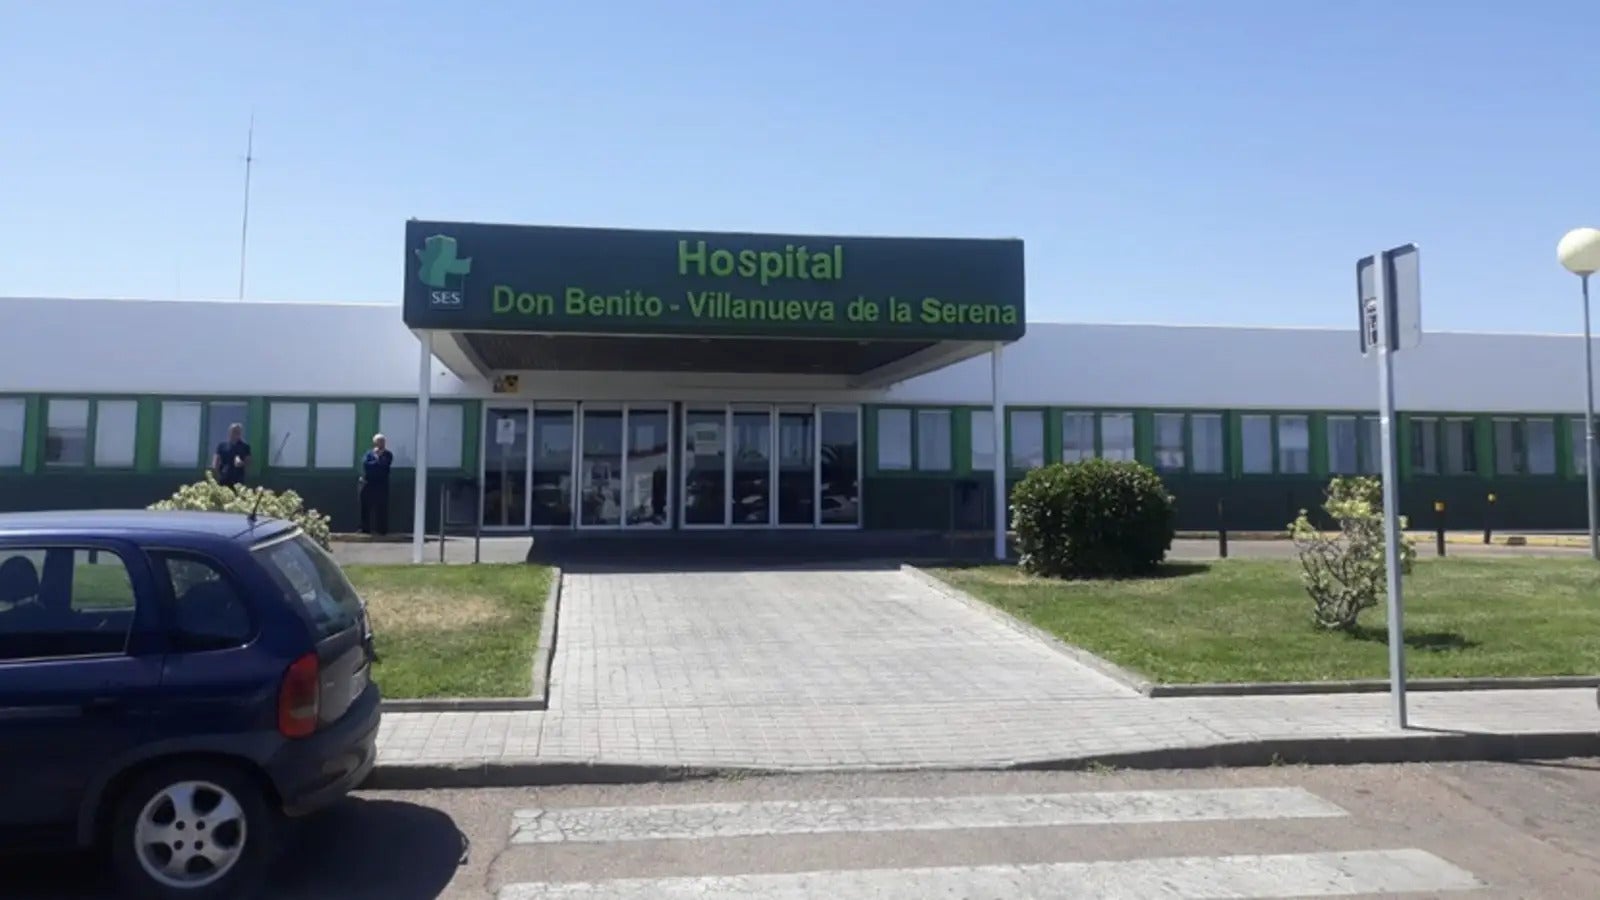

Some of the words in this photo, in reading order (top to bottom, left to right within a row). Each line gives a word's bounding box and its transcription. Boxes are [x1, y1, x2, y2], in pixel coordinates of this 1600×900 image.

[678, 240, 843, 284] Hospital
[432, 291, 461, 304] SES
[493, 285, 554, 315] Don
[565, 287, 663, 317] Benito
[688, 292, 835, 322] Villanueva
[848, 296, 879, 322] de
[890, 297, 912, 323] la
[921, 298, 1017, 325] Serena
